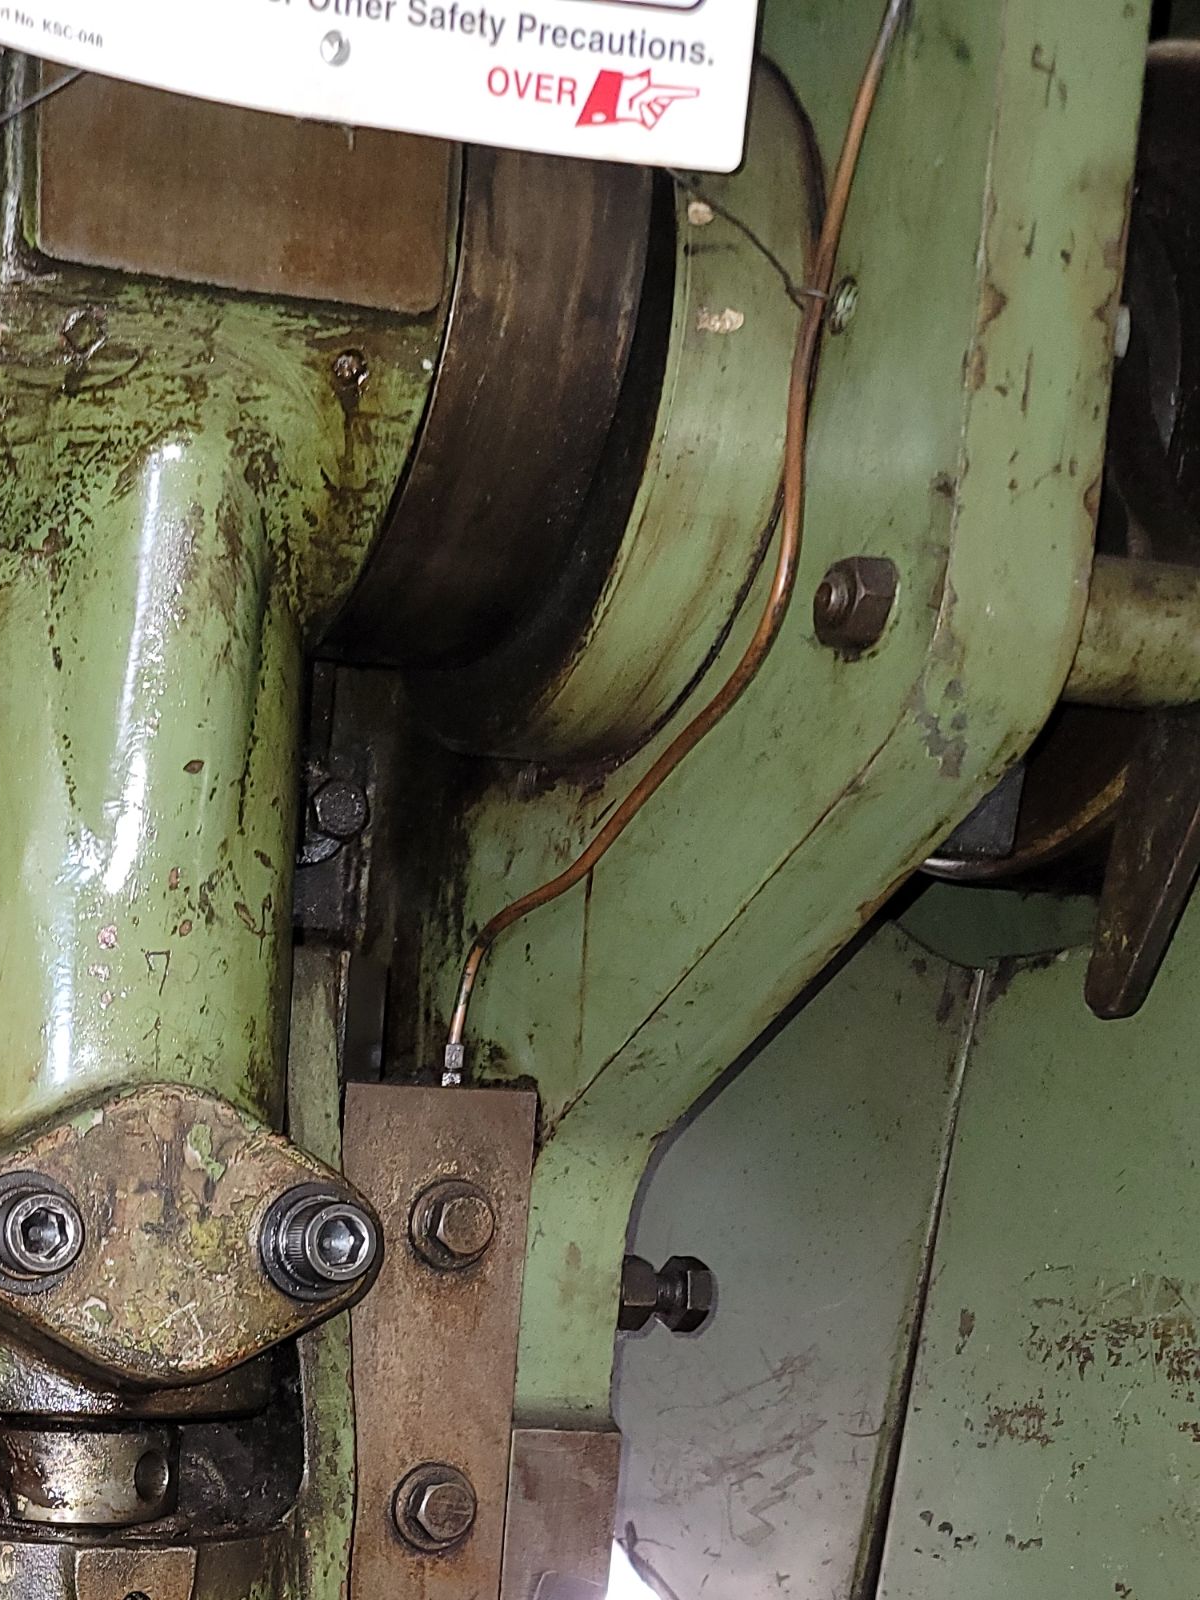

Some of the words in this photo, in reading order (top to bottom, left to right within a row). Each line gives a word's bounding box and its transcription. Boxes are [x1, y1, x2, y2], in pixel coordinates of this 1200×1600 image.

[406, 0, 506, 45] Safety
[516, 13, 716, 67] Precautions.
[487, 66, 578, 107] OVER
